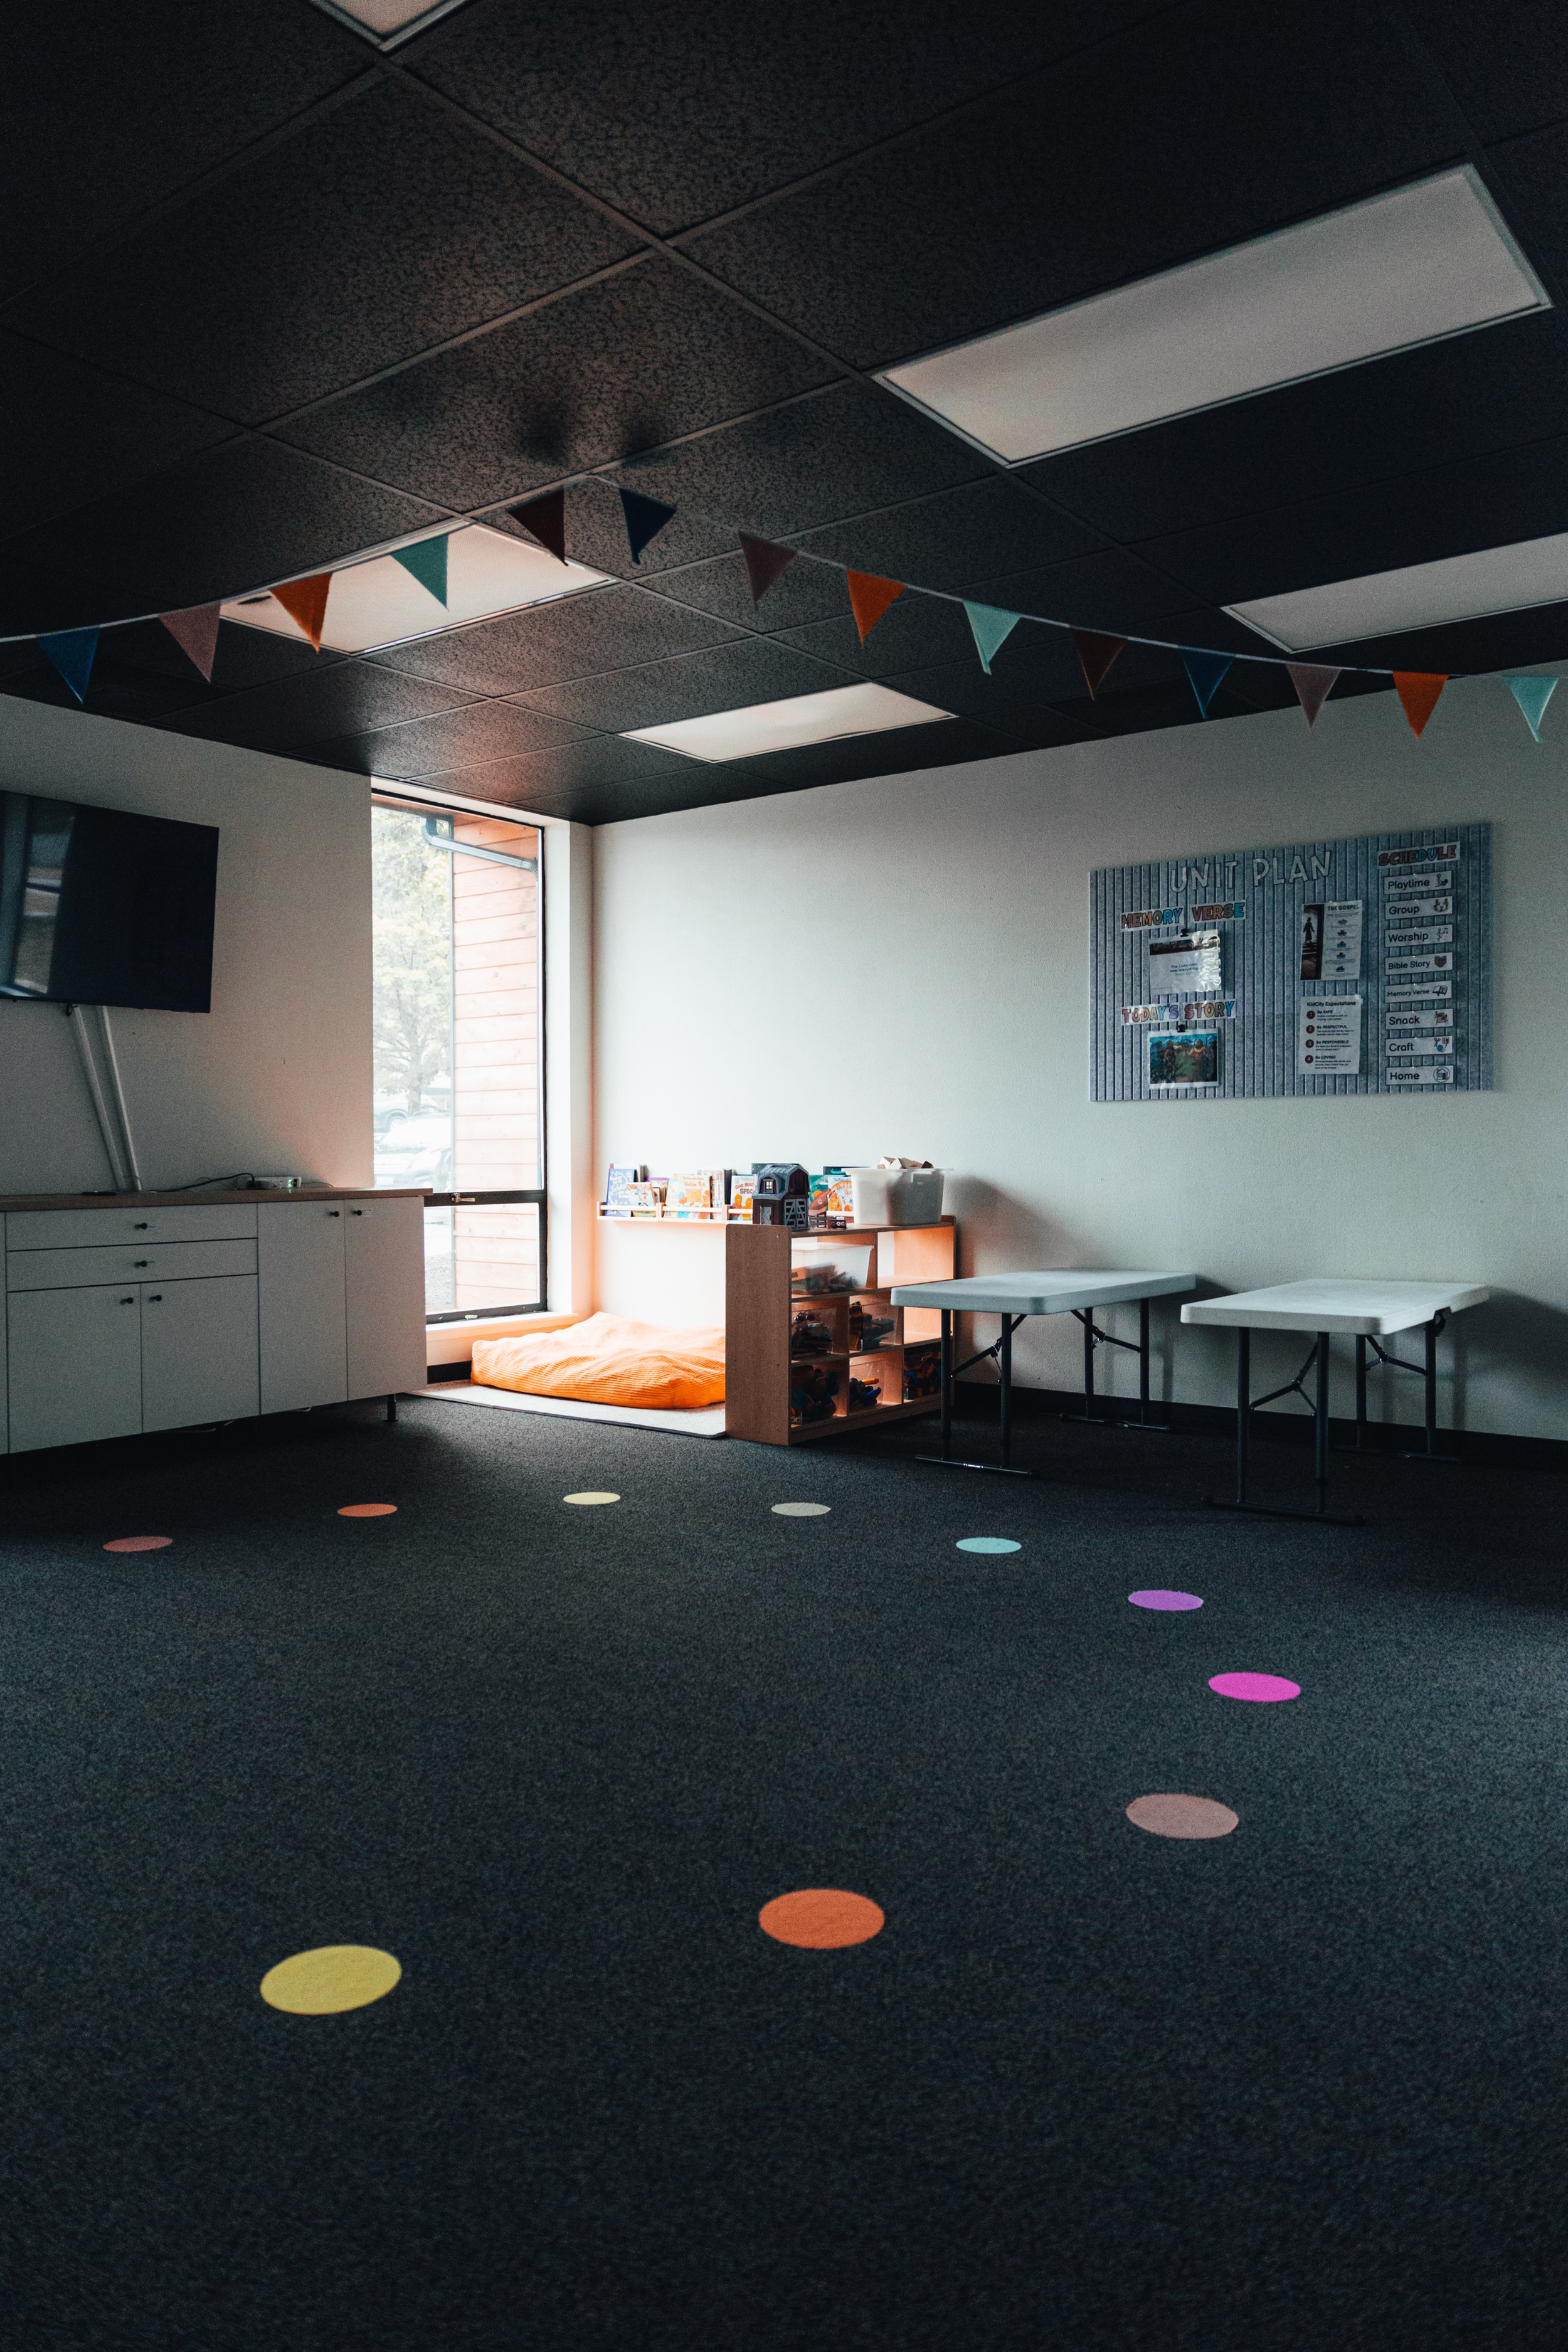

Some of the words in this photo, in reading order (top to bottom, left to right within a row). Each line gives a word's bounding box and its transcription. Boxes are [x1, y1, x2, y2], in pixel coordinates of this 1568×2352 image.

[1378, 844, 1457, 867] SCHEDULE
[1170, 860, 1238, 893] UNIT
[1252, 850, 1331, 887] PLAN
[1388, 879, 1431, 891] Playtime
[1121, 908, 1184, 929] MEMORY
[1191, 901, 1246, 922] VERSE
[1389, 905, 1420, 916] Group
[1388, 931, 1429, 943] Worship
[1388, 962, 1408, 970] Bible
[1410, 960, 1431, 970] Story
[1121, 1004, 1179, 1024] TODAY'S
[1184, 1000, 1236, 1020] STORY
[1389, 1015, 1420, 1025] Snack
[1389, 1042, 1414, 1052] Craft
[1390, 1071, 1420, 1081] Home
